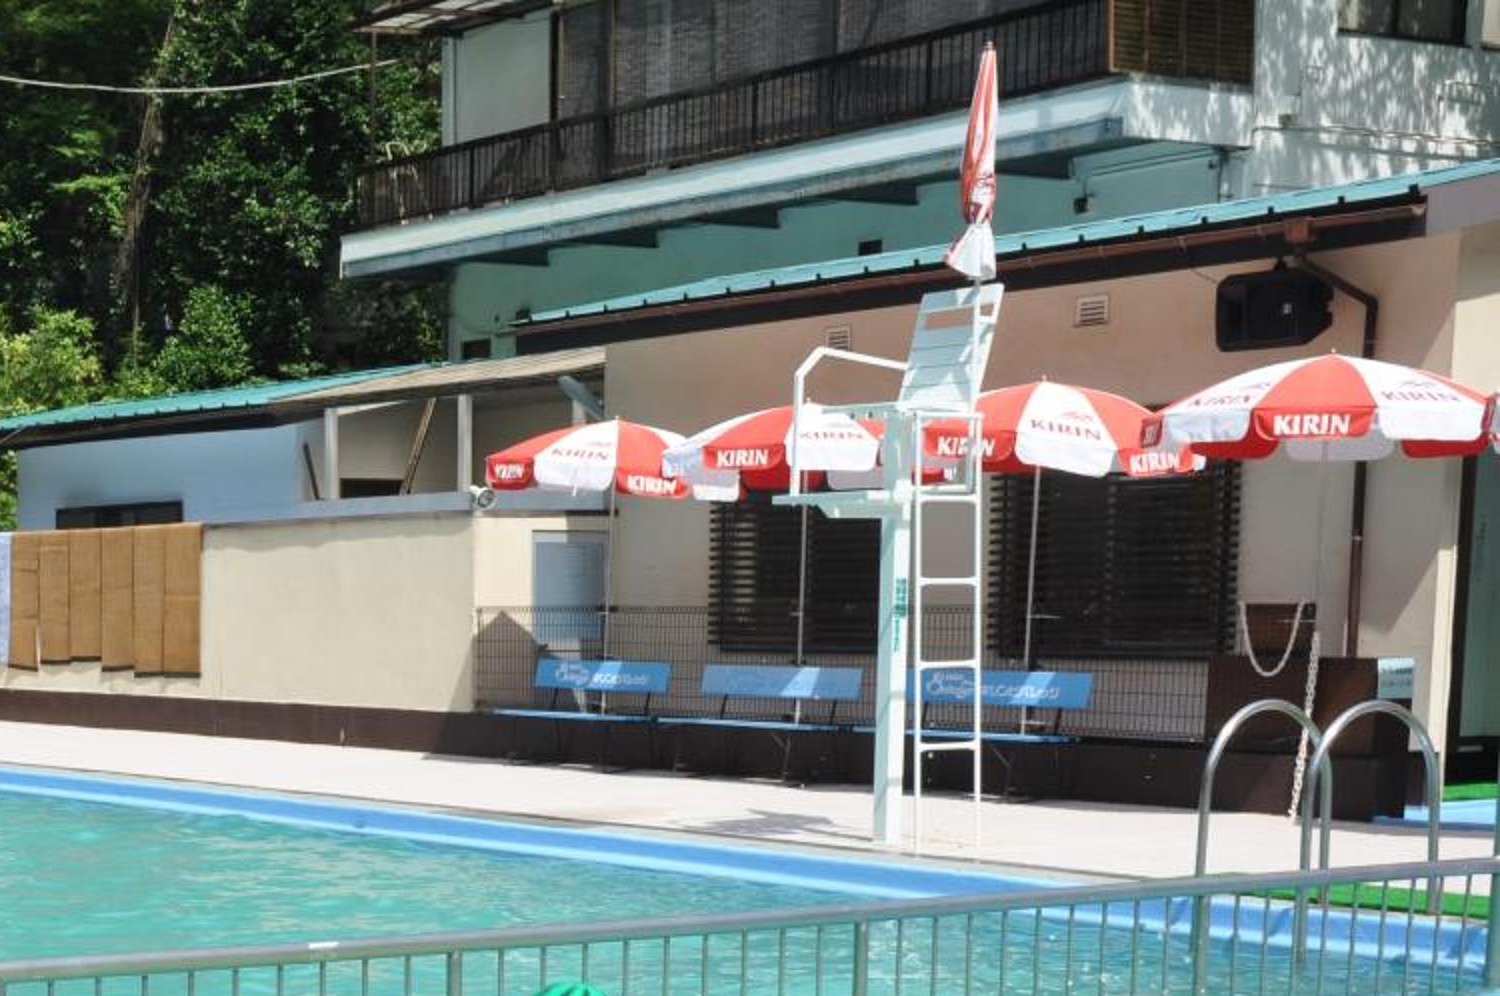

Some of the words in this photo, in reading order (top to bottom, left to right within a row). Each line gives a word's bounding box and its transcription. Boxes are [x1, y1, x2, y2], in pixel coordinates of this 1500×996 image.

[1031, 419, 1101, 441] KIRIN
[1273, 413, 1351, 435] KIRIN
[551, 447, 610, 461] KIRIN
[716, 448, 769, 467] KIRIN
[1130, 452, 1179, 473] KIRIN
[627, 475, 677, 497] KIRIN
